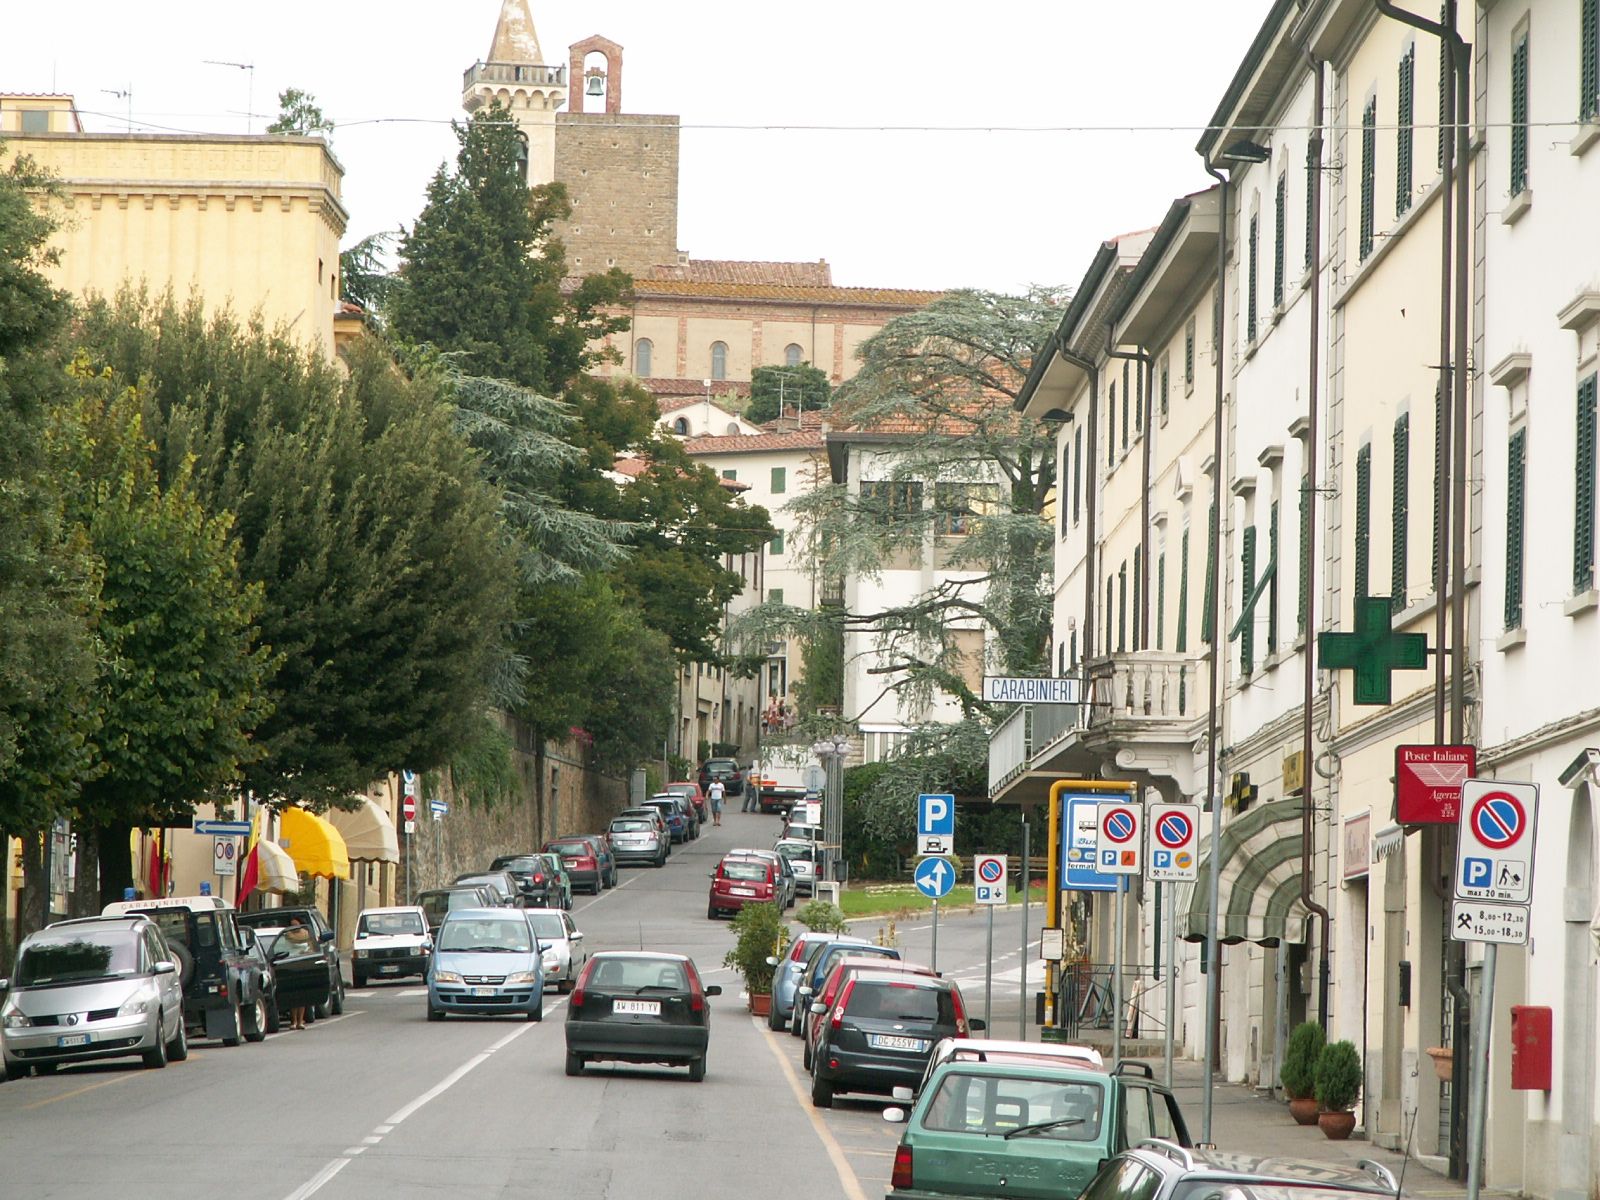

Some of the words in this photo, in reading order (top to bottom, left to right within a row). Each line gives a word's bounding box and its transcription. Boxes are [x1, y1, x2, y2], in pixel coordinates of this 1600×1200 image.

[992, 679, 1072, 701] CARABINIERI
[1404, 751, 1430, 761] Poste
[1433, 750, 1468, 761] Italiane
[1429, 790, 1462, 803] Agenzi
[925, 799, 948, 831] P
[1105, 852, 1114, 864] P
[1157, 853, 1168, 866] P
[1469, 861, 1487, 884] P
[980, 889, 988, 898] P
[1498, 891, 1513, 899] min.
[121, 899, 193, 909] CARABINIERI
